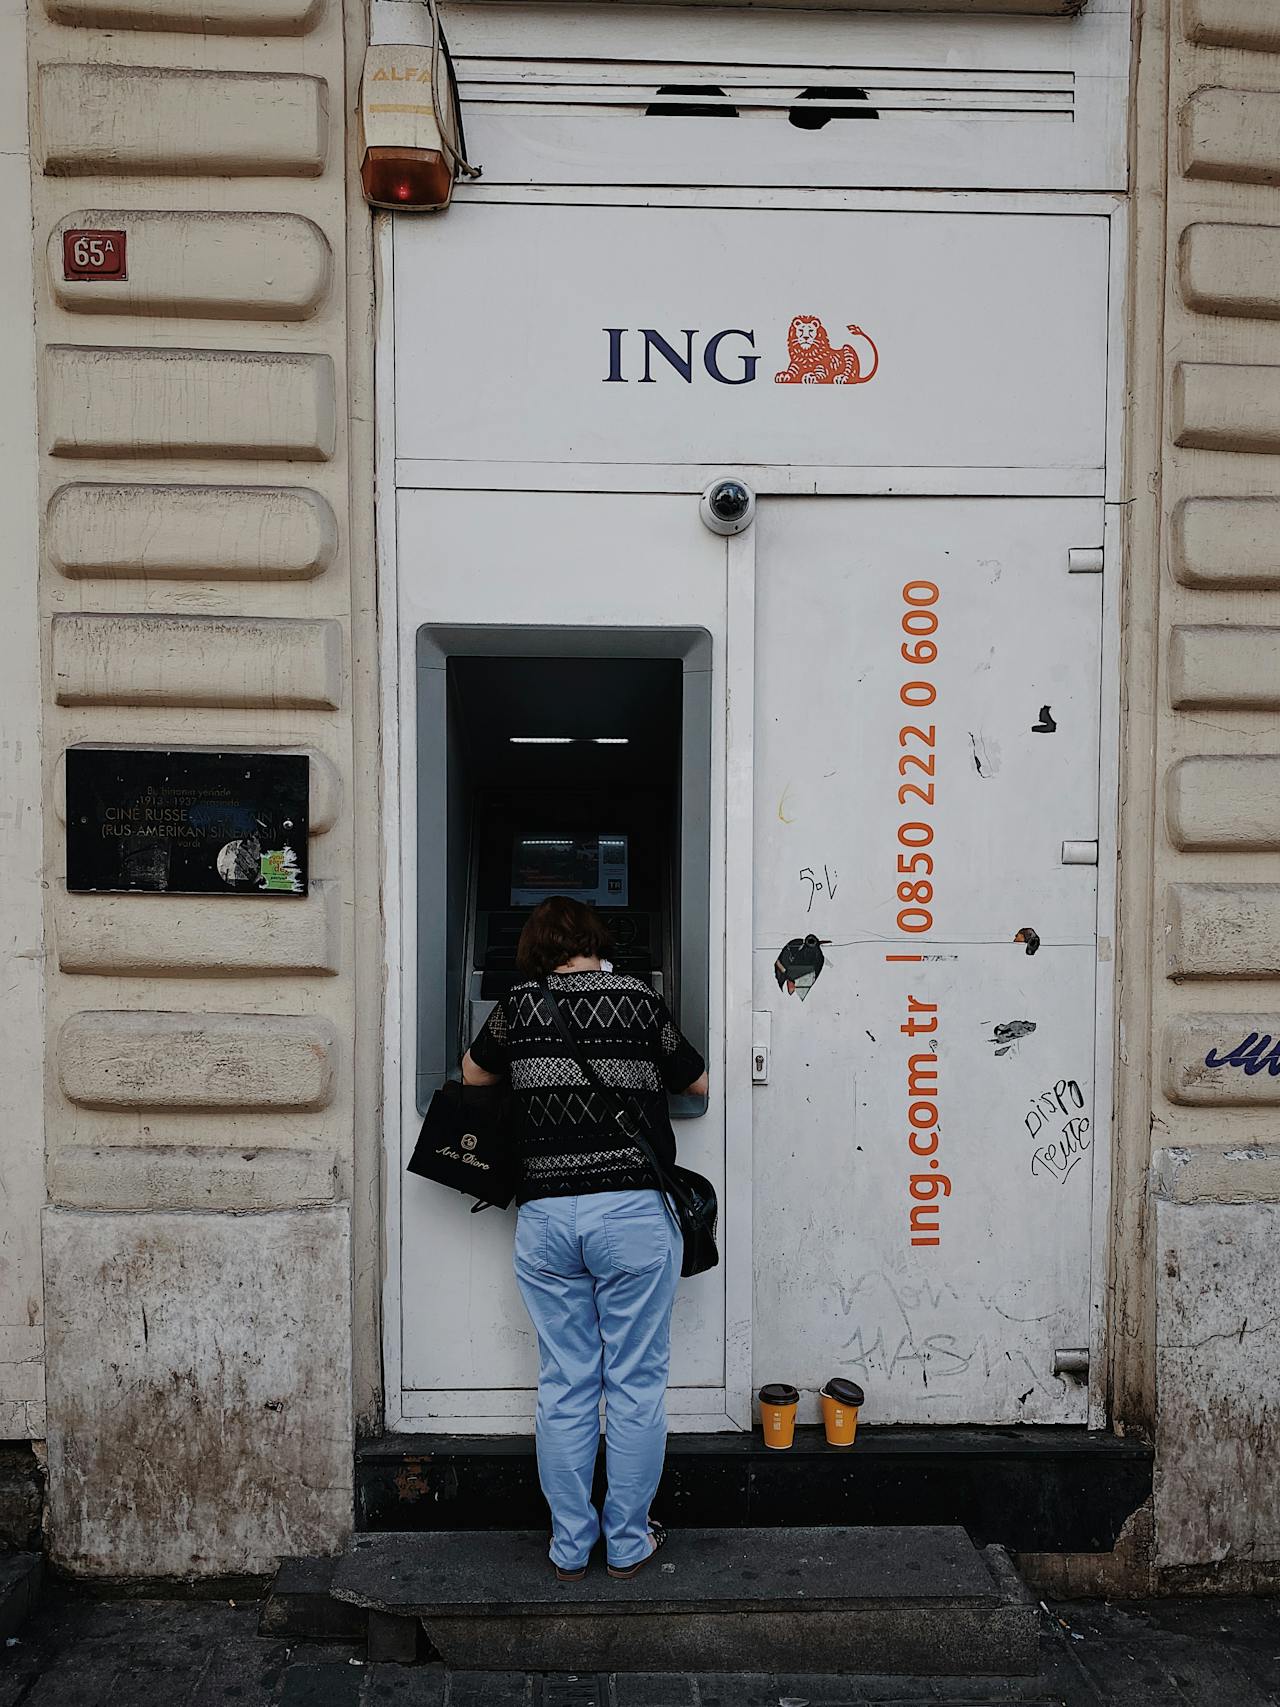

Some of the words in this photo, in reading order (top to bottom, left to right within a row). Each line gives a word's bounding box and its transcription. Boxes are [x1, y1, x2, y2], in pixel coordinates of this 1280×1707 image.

[372, 67, 432, 82] ALFA
[602, 328, 762, 385] ING
[901, 580, 940, 665] 600
[900, 681, 937, 707] 0
[898, 725, 936, 806] 222
[896, 821, 935, 933] 0850
[900, 995, 952, 1247] ing.comtr
